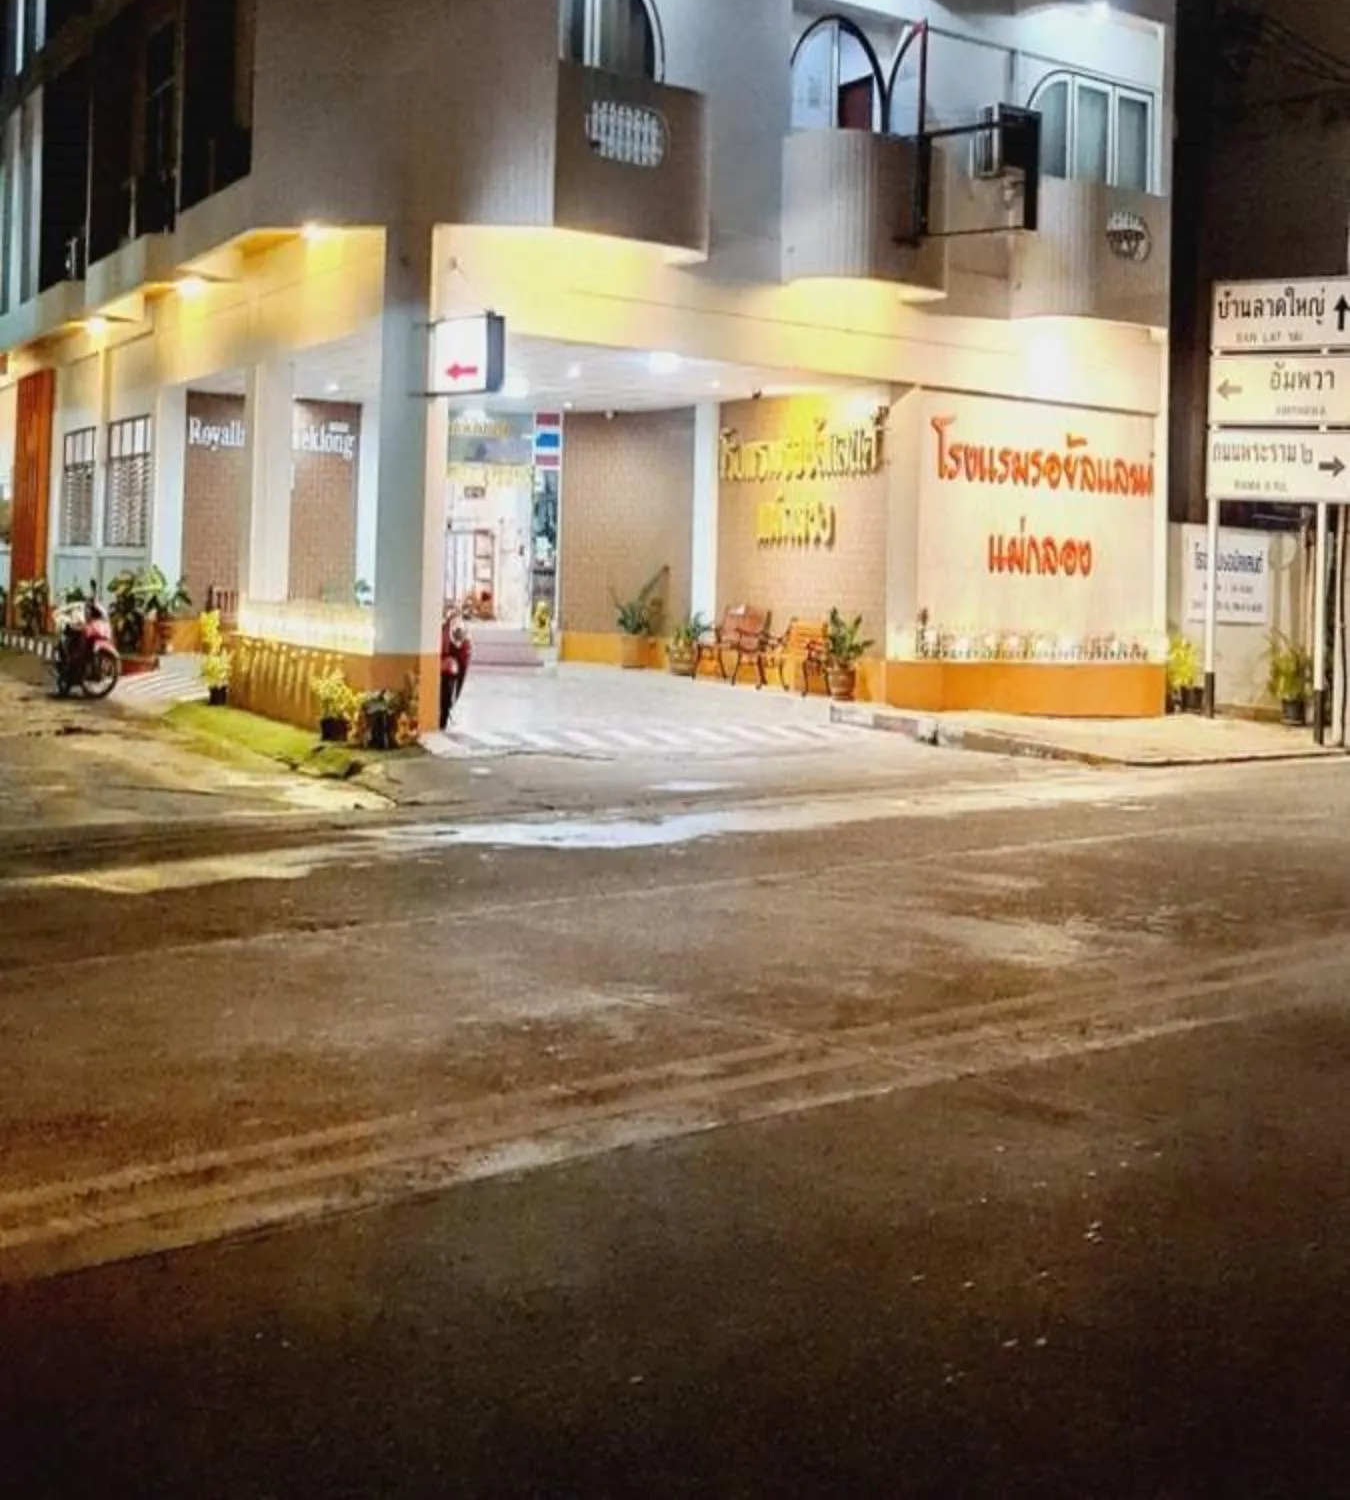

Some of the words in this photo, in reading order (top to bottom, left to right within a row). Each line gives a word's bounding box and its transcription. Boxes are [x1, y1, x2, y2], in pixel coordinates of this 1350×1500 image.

[1218, 286, 1326, 325] บ้านลาดใหญ่
[1270, 361, 1335, 392] อัมพวา
[988, 514, 1094, 577] แม่กลอง
